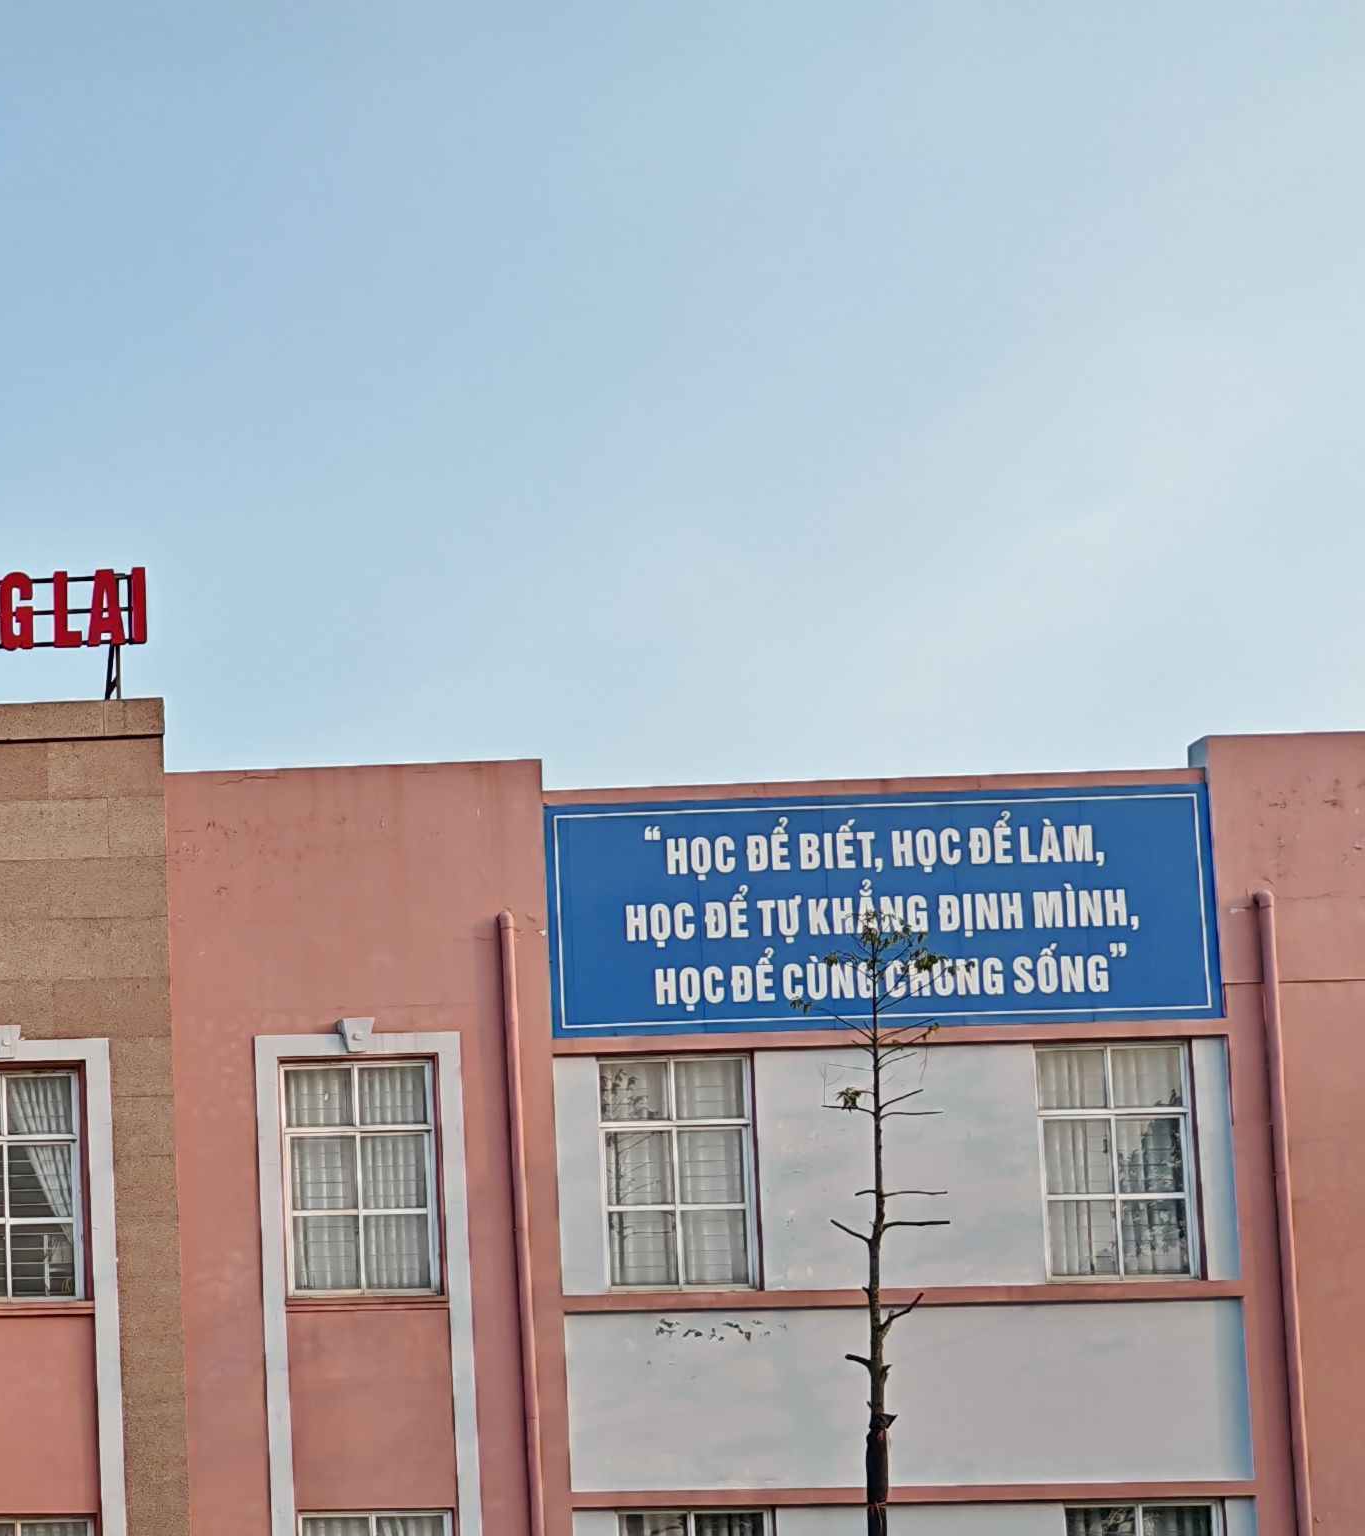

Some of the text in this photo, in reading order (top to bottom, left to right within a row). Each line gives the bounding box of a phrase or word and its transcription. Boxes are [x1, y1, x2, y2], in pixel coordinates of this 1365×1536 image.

[53, 567, 146, 647] LAI
[746, 816, 791, 872] ĐỂ
[799, 819, 883, 873] BIẾT,
[891, 827, 961, 873] HỌC
[968, 810, 1013, 865] ĐỂ
[1019, 818, 1105, 866] LÀM,
[625, 902, 695, 948] HỌC
[704, 884, 749, 939] ĐỂ
[756, 895, 802, 944] TỰ
[938, 892, 1023, 937] ĐỊNH
[1033, 883, 1139, 930] MÌNH,
[655, 966, 725, 1012] HỌC
[730, 947, 776, 1003] ĐỂ
[783, 963, 878, 1000] CÙNG
[887, 954, 1004, 997] CHUNG
